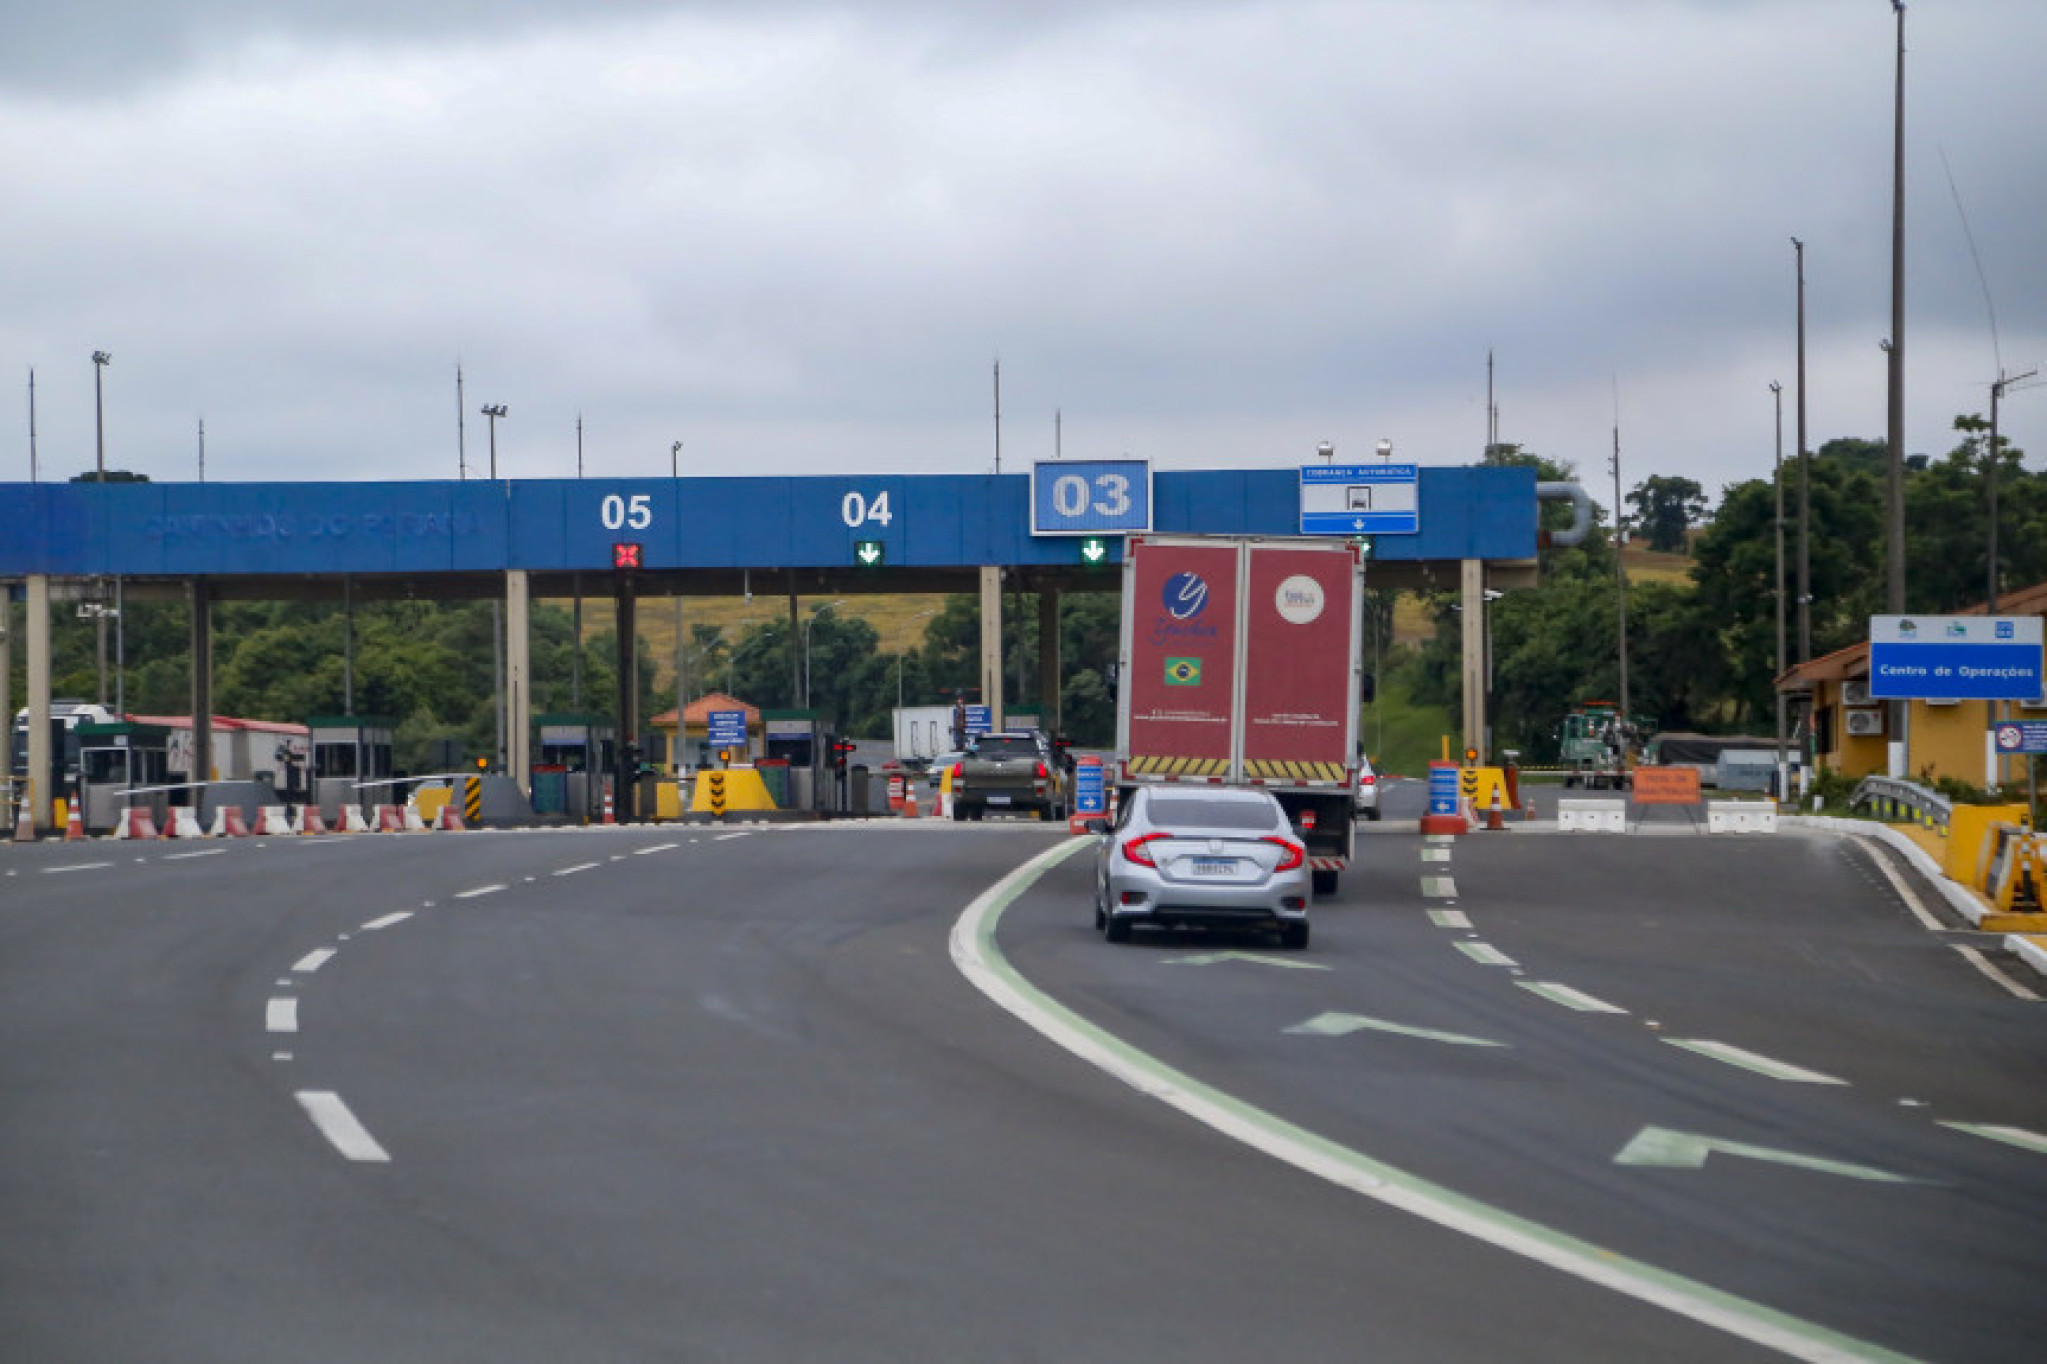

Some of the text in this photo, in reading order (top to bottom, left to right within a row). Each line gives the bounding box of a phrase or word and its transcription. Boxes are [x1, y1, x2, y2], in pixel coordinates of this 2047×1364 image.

[601, 495, 652, 530] 05
[841, 491, 893, 527] 04
[1052, 473, 1133, 518] 03
[1880, 664, 2034, 680] Centro de Operações
